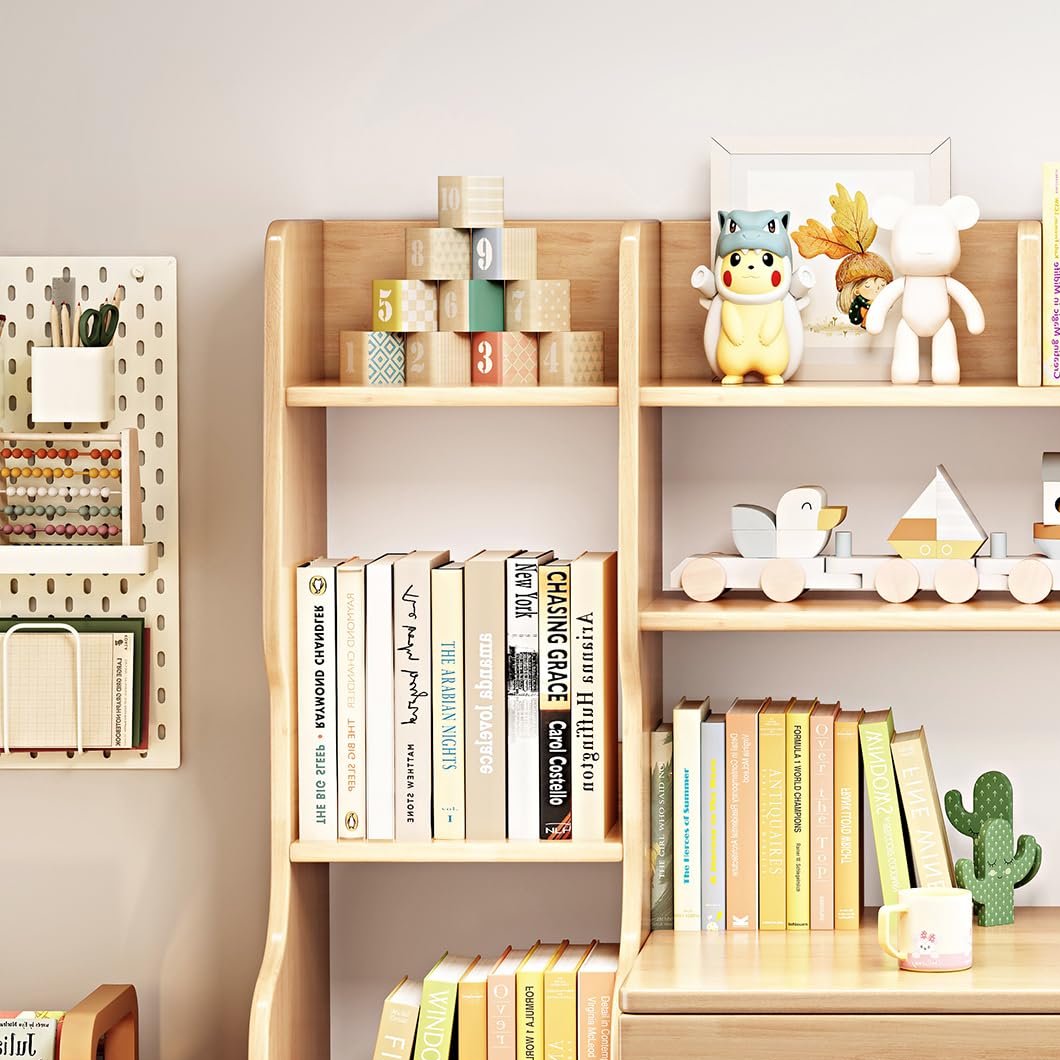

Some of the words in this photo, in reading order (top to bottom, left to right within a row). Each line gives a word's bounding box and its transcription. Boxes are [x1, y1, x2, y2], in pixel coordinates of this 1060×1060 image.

[441, 186, 460, 211] 10
[411, 239, 424, 267] 8
[476, 237, 493, 270] 9
[378, 289, 393, 322] 5
[445, 291, 457, 318] 6
[512, 291, 526, 321] 7
[346, 341, 355, 373] 1
[411, 341, 425, 372] 2
[477, 341, 493, 374] 3
[543, 341, 559, 373] 4
[515, 563, 537, 588] New
[515, 591, 538, 618] York
[547, 571, 568, 644] CHASING
[440, 641, 456, 664] THE
[547, 649, 568, 702] GRACE
[441, 668, 456, 722] ARABIAN
[441, 725, 457, 770] NIGHTS
[548, 720, 567, 751] Carol
[794, 725, 802, 759] FORMULA
[549, 755, 568, 806] Costello
[794, 765, 802, 790] WORLD
[683, 816, 690, 826] of
[766, 768, 783, 875] ANTIQUAIRES
[585, 996, 596, 1025] Virginia
[600, 995, 610, 1018] Detail
[587, 1027, 596, 1058] McLeod
